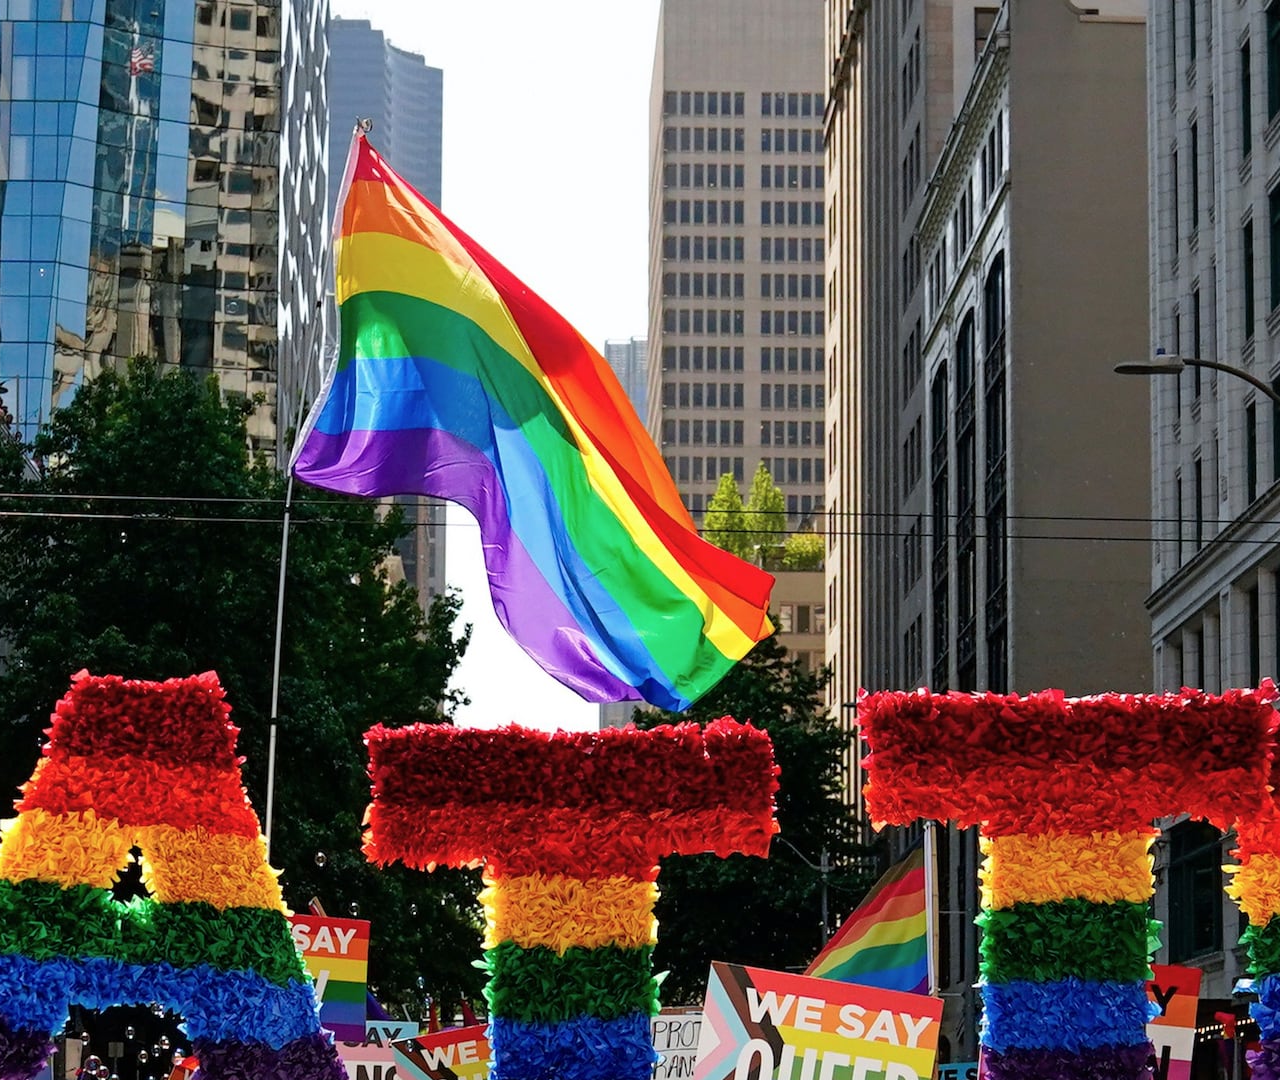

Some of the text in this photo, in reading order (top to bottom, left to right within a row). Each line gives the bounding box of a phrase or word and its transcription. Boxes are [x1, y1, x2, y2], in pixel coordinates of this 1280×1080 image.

[291, 925, 357, 955] SAY
[746, 987, 933, 1049] WE SAY
[342, 1027, 403, 1048] AY
[652, 1020, 702, 1048] PROT
[421, 1040, 480, 1071] WE
[652, 1055, 697, 1080] RAN
